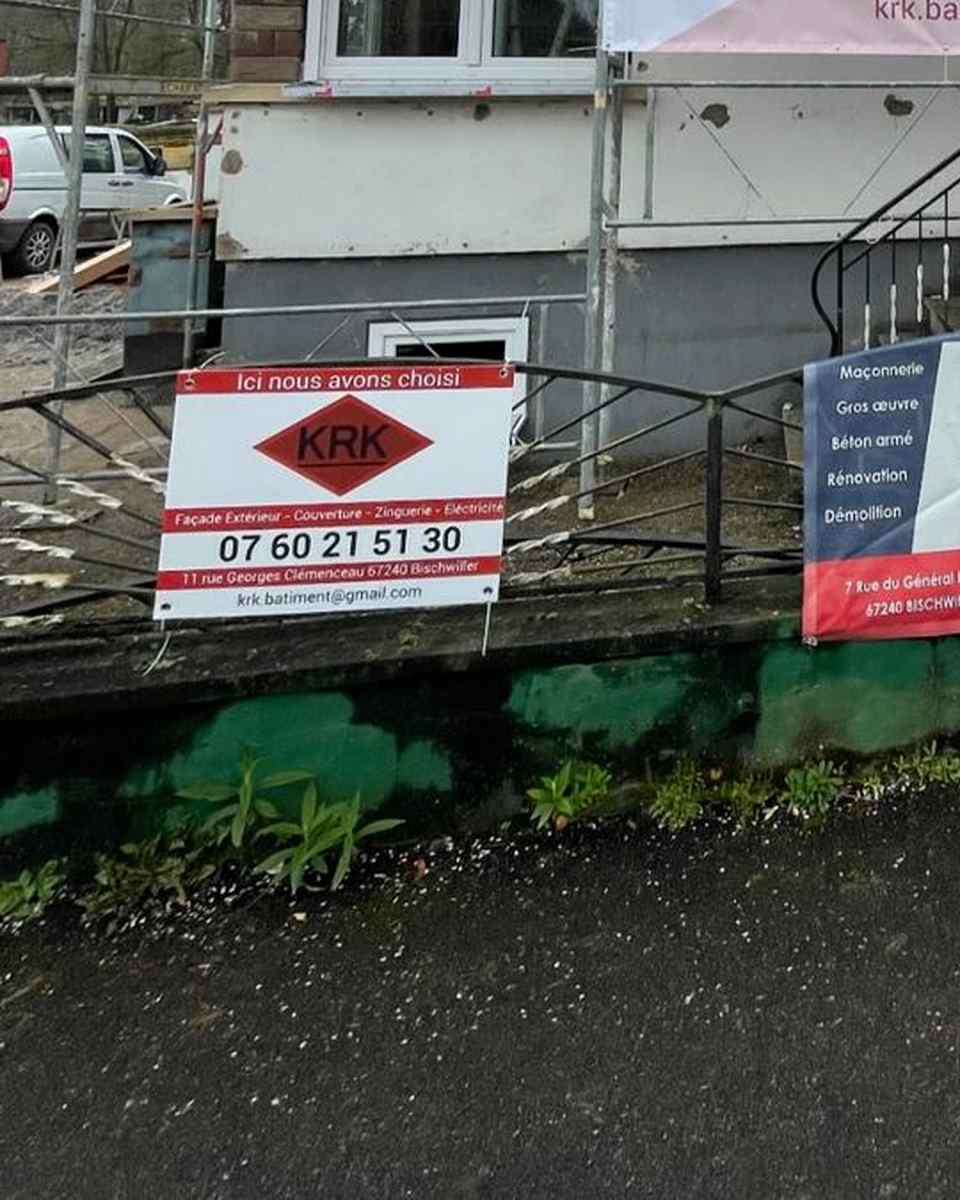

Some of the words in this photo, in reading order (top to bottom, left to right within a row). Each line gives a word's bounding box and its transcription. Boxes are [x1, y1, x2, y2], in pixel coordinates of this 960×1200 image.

[236, 373, 263, 391] Ici
[268, 373, 322, 390] nous
[328, 372, 393, 389] avons
[397, 368, 461, 388] choisi
[840, 363, 925, 380] Maçonnerie
[836, 399, 869, 415] Gros
[873, 399, 919, 412] œuvre
[297, 423, 389, 461] KRK
[832, 435, 873, 451] Béton
[876, 433, 913, 448] armé
[827, 469, 908, 486] Rénovation
[175, 512, 222, 527] Façade
[293, 507, 362, 522] Couverture
[374, 506, 432, 519] Zinguerie
[825, 505, 901, 523] Démolition
[219, 535, 260, 563] 07
[271, 533, 311, 560] 60
[322, 531, 358, 558] 21
[373, 529, 408, 556] 51
[422, 526, 461, 554] 30
[201, 574, 223, 585] rue
[226, 571, 281, 584] Georges
[284, 566, 364, 581] Clémenceau
[367, 563, 408, 577] 67240
[856, 580, 879, 593] Rue
[883, 577, 899, 591] du
[903, 572, 954, 589] Général
[237, 586, 422, 607] krk.batiment@gmail.com
[865, 602, 903, 617] 67240
